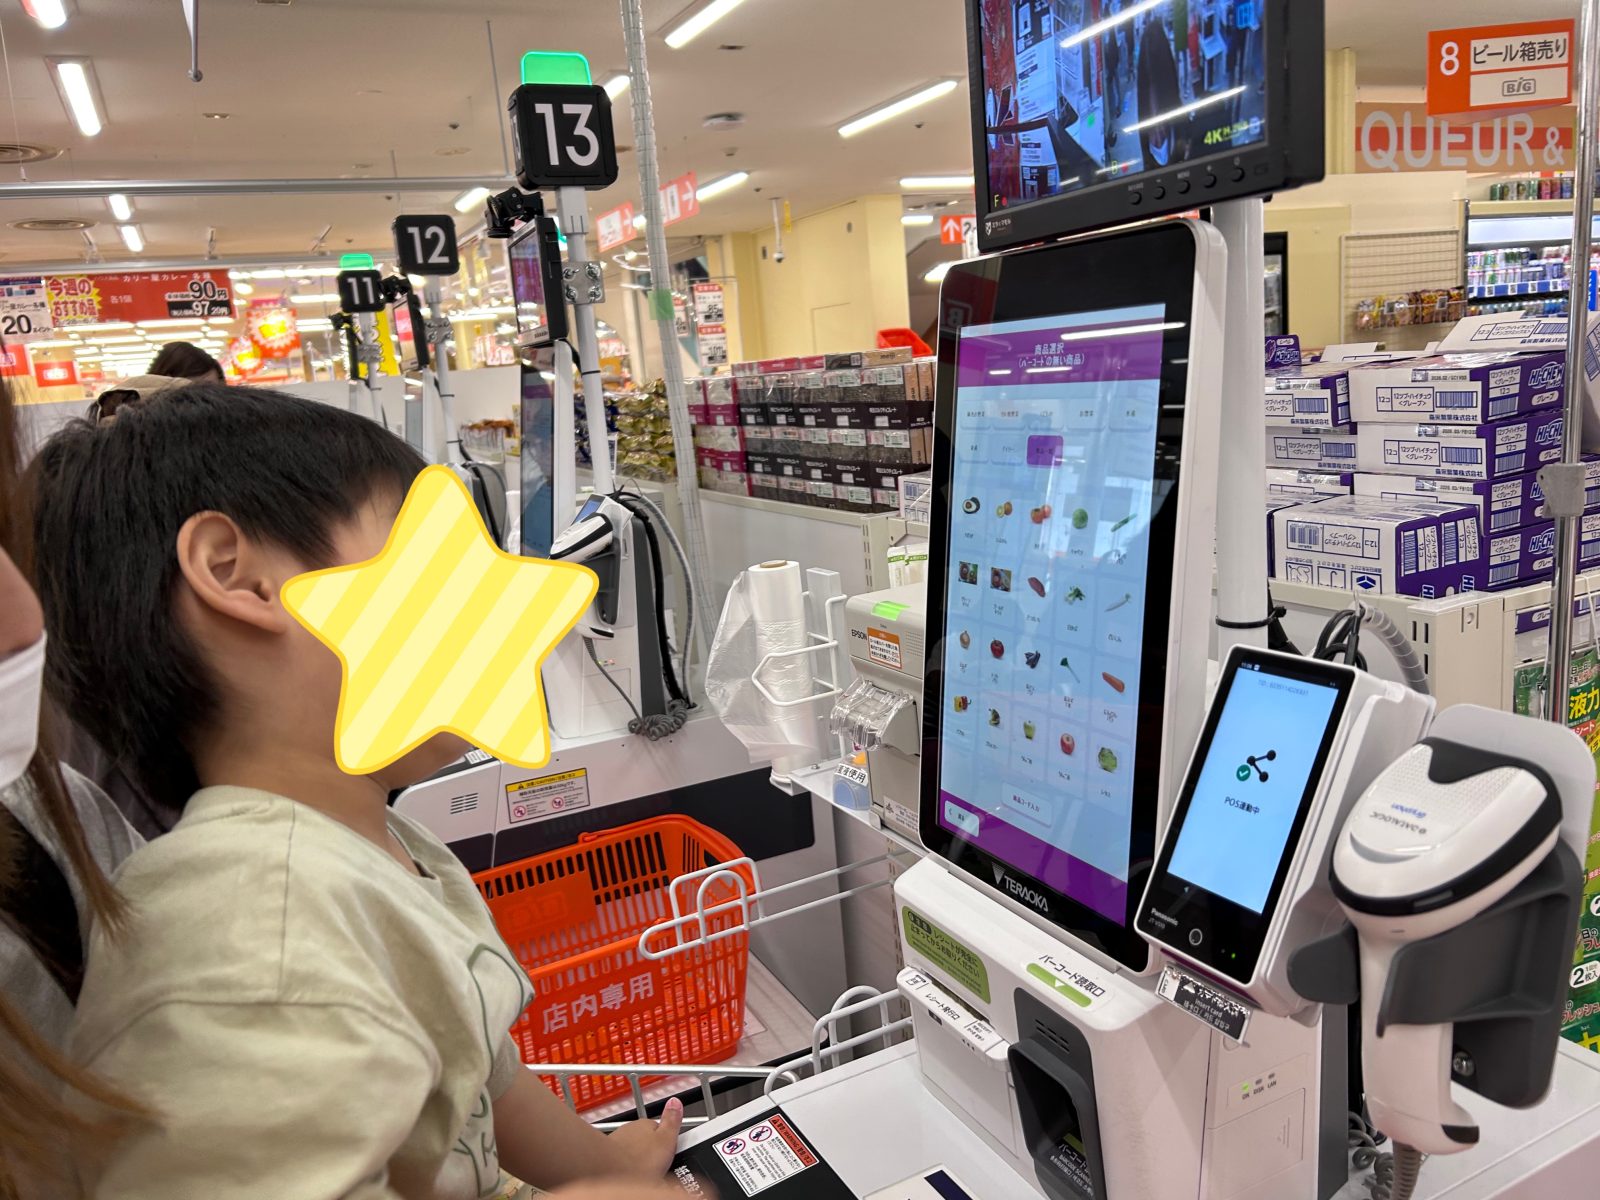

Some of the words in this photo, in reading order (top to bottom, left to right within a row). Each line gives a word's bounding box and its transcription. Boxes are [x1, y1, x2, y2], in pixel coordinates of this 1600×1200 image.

[1440, 41, 1460, 76] 8
[1473, 38, 1567, 64] ビール箱売り
[535, 103, 600, 166] 13
[1543, 127, 1565, 165] &
[407, 225, 450, 264] 12
[48, 278, 91, 297] 今週の
[347, 277, 375, 304] 11
[53, 298, 97, 316] おすすめ品
[2, 314, 32, 335] 20
[1034, 342, 1065, 355] 商品選択
[1365, 539, 1377, 548] 12コ
[851, 629, 867, 641] EPSON
[1004, 875, 1049, 912] TERAOKA
[1151, 907, 1179, 926] Panasonic
[1039, 954, 1106, 997] バーコード読取口
[1573, 968, 1584, 986] 2
[1585, 971, 1598, 981] 枚入
[543, 971, 655, 1034] 店内専用
[1210, 1008, 1223, 1018] card
[1267, 1081, 1277, 1089] LAN
[1242, 1092, 1250, 1100] ON
